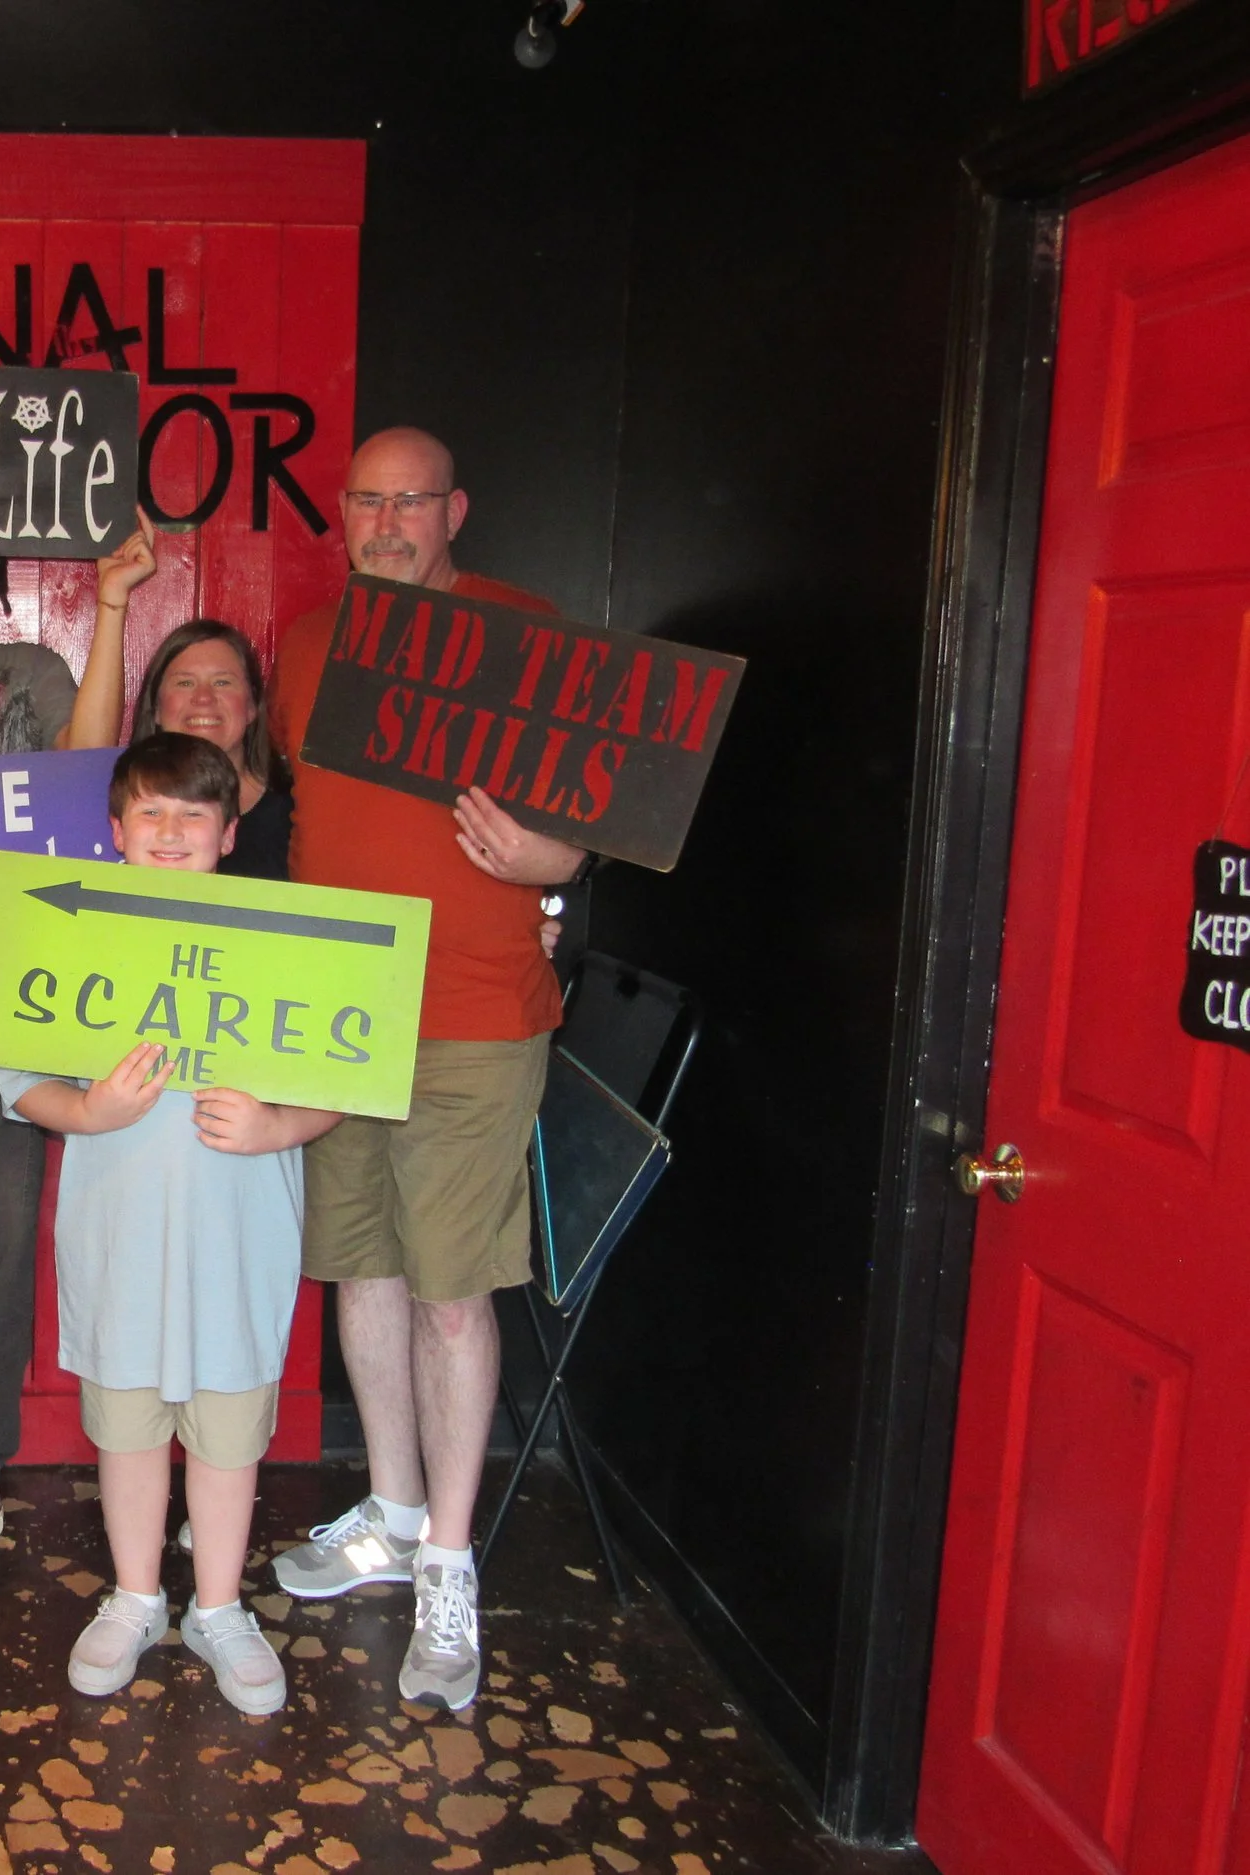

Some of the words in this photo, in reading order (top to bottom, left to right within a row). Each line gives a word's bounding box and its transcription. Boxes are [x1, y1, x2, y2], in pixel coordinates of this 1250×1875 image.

[333, 585, 486, 690] MAD
[510, 624, 730, 753] TEAM
[364, 685, 627, 823] SKILLS
[170, 944, 225, 982] HE
[1192, 910, 1250, 956] KEEP
[14, 967, 372, 1065] SCARES
[152, 1046, 217, 1084] ME
